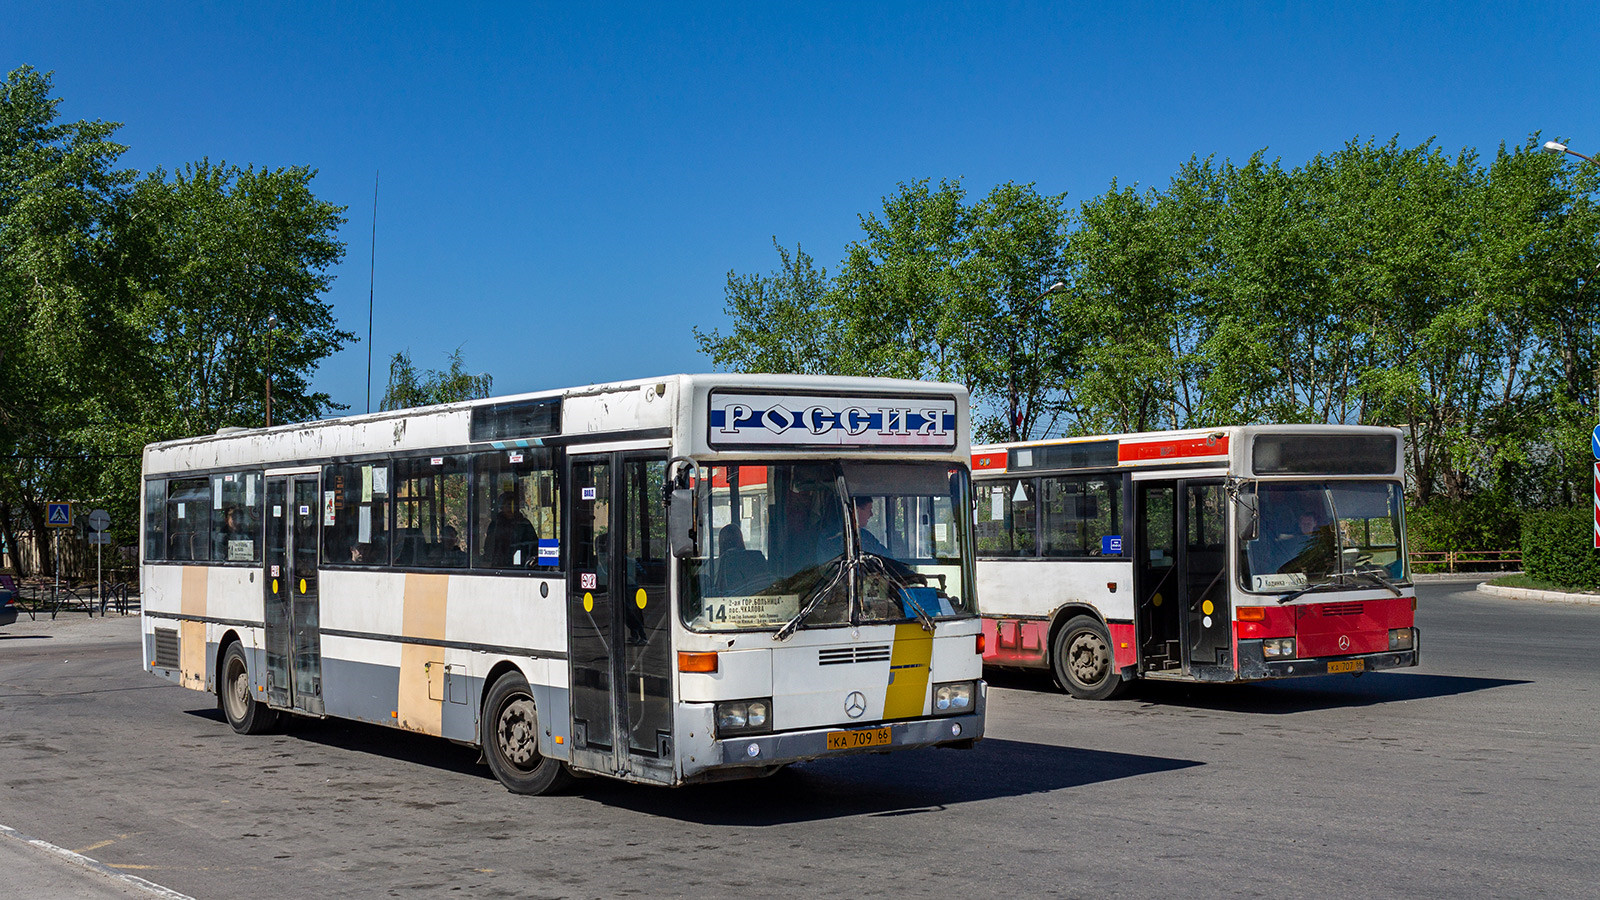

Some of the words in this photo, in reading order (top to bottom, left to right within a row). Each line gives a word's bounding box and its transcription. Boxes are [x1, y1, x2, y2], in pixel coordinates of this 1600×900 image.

[720, 404, 947, 436] РОССИЯ
[705, 604, 727, 623] 14
[852, 732, 872, 745] 709
[878, 729, 888, 739] 66
